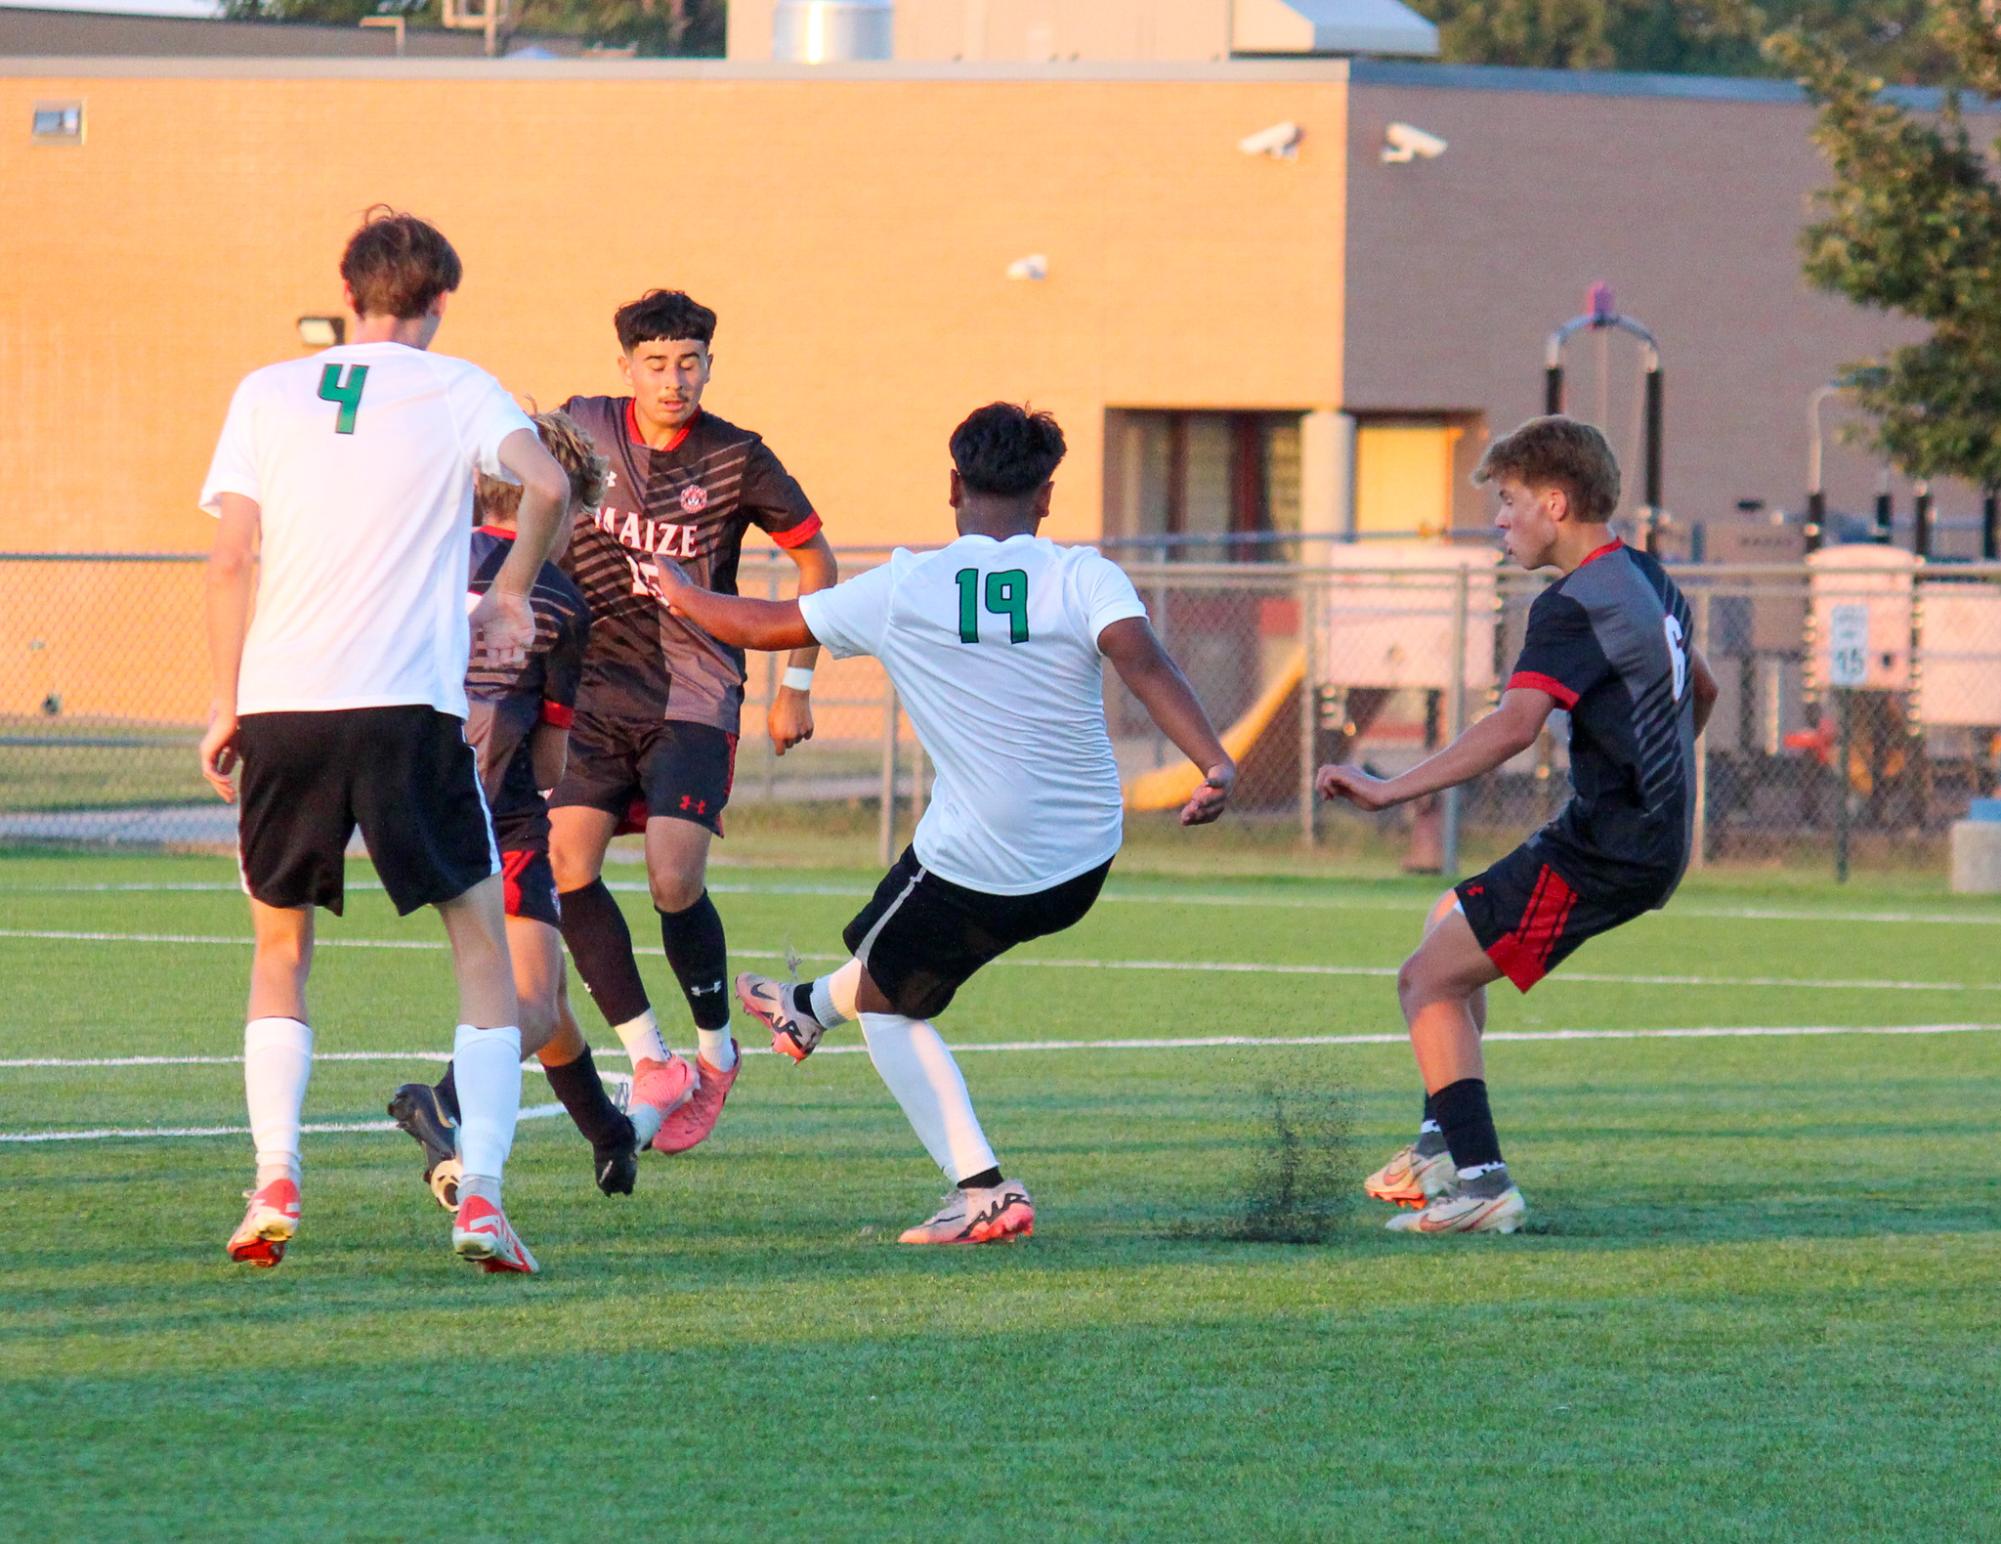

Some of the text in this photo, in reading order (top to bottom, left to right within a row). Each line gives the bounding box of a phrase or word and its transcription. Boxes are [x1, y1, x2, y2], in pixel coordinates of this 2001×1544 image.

[317, 363, 370, 434] 4
[955, 568, 1029, 644] 19
[1664, 614, 1686, 701] 6
